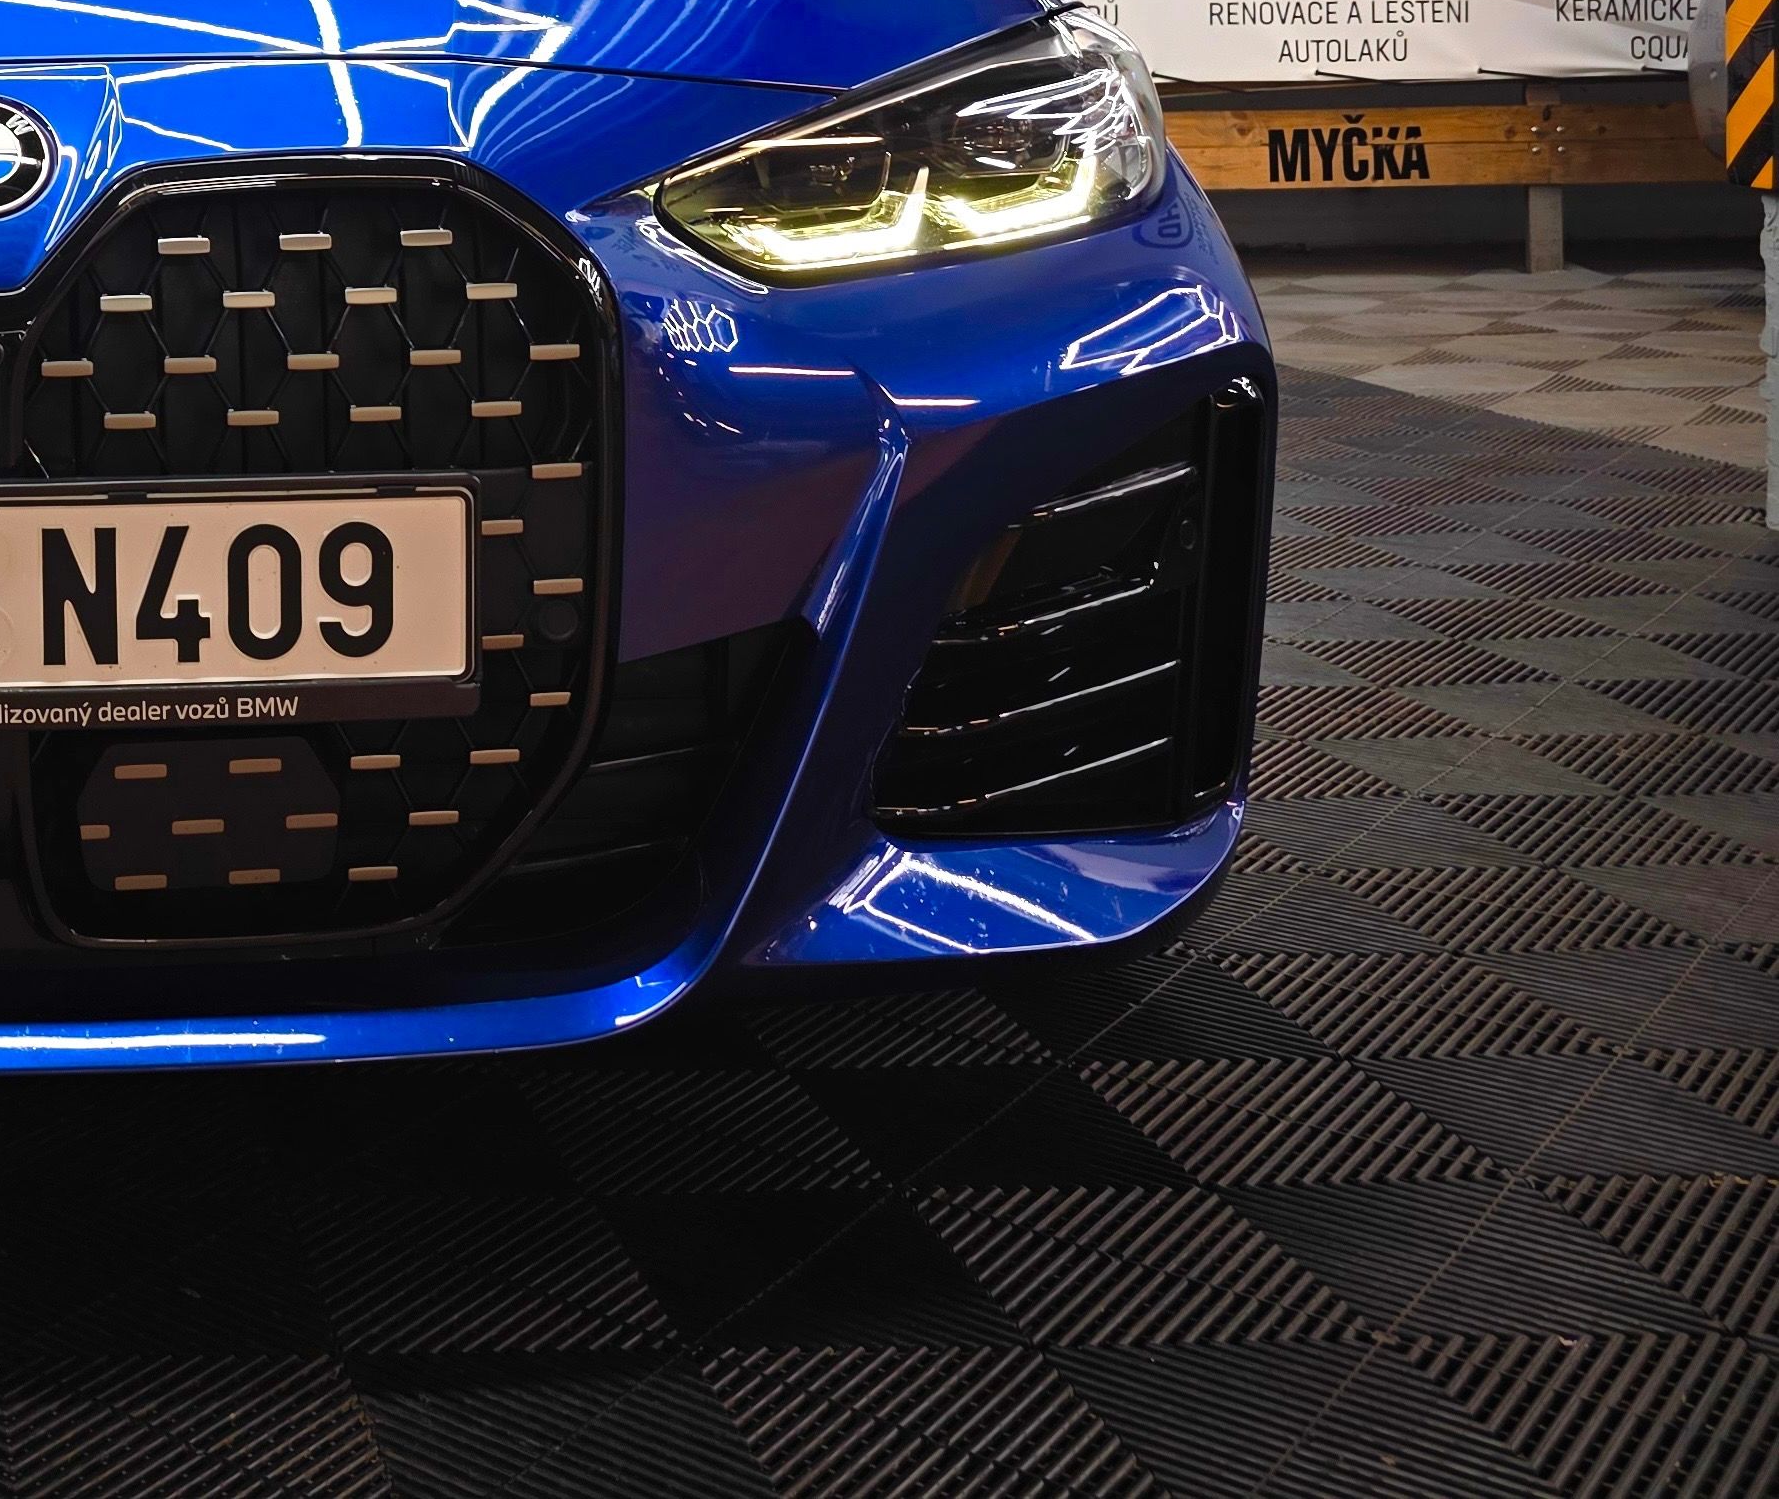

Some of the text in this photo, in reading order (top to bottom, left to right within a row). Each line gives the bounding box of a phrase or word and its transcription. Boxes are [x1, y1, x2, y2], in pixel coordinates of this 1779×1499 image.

[1209, 2, 1339, 26] RENOVACE
[1346, 1, 1363, 24] A
[1278, 29, 1408, 63] AUTOLAKŮ
[1630, 33, 1688, 62] CQU
[1269, 114, 1430, 183] MYČKA
[42, 522, 394, 668] N409
[98, 700, 172, 722] dealer
[174, 696, 229, 720] vozů
[237, 696, 299, 718] BMW
